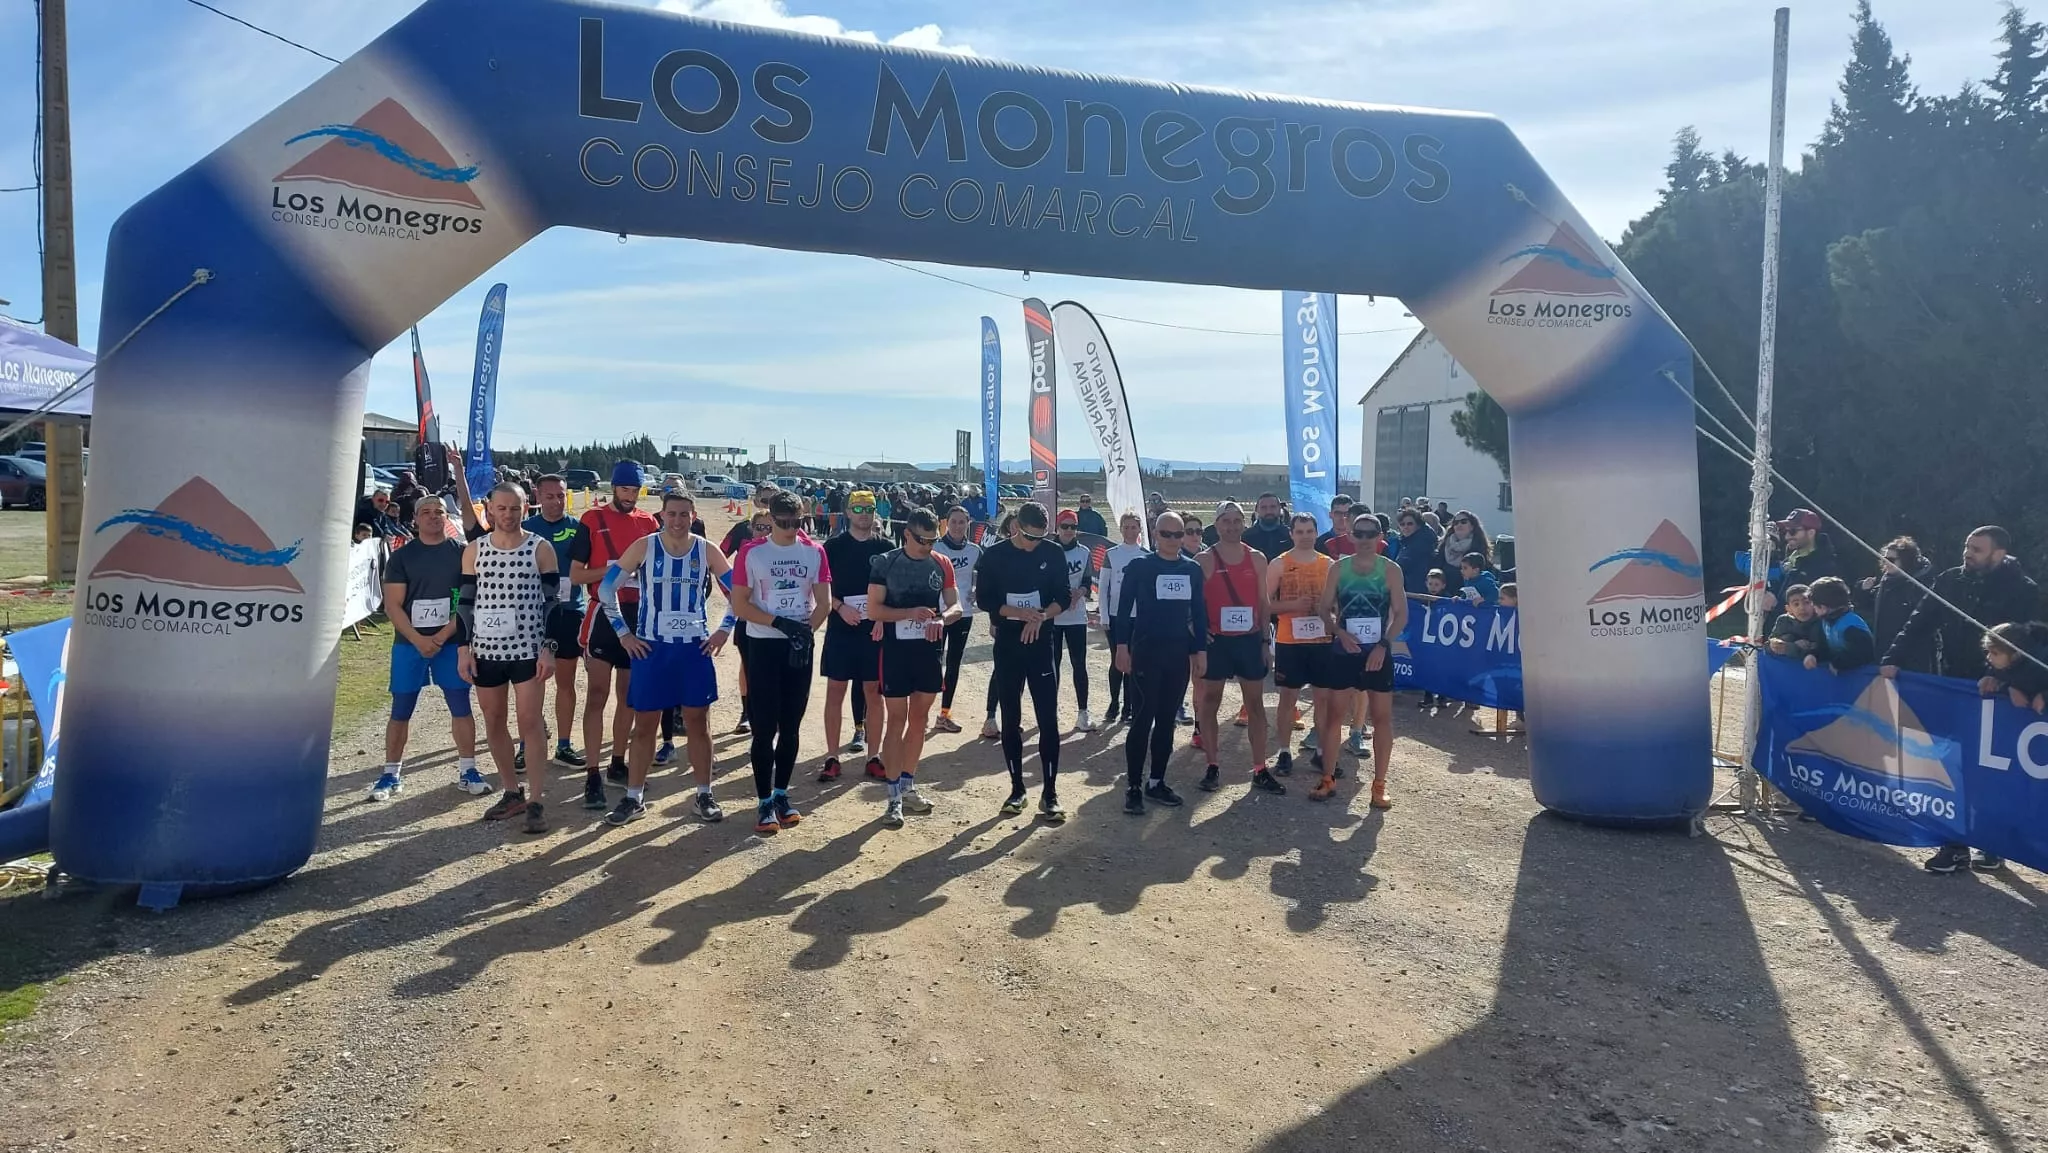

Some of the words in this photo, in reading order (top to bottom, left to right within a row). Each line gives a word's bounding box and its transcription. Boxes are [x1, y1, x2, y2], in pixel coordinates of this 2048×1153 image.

[579, 16, 813, 144] Los
[865, 58, 1451, 216] Monegros
[578, 136, 874, 213] CONSEJO
[898, 173, 1198, 243] COMARCAL
[272, 186, 324, 214] Los
[336, 195, 483, 235] Monegros
[271, 210, 339, 230] CONSEJO
[344, 220, 421, 241] COMARCAL
[1489, 299, 1527, 317] Los
[1534, 300, 1632, 322] Monegros
[1487, 315, 1535, 328] CONSEJO
[1538, 319, 1593, 328] COMARCAL
[475, 333, 494, 425] Monegros
[473, 430, 485, 461] Los
[1167, 582, 1181, 592] 48
[86, 585, 123, 613] Los
[134, 590, 304, 628] Monegros
[780, 597, 795, 608] 97
[424, 608, 438, 619] 74
[486, 617, 501, 628] 24
[1231, 614, 1243, 625] 54
[1589, 607, 1631, 626] Los
[85, 613, 137, 630] CONSEJO
[142, 618, 232, 635] COMARCAL
[671, 618, 687, 630] 29
[1303, 623, 1315, 632] 19
[1357, 624, 1371, 635] 78
[1486, 607, 1521, 654] M
[1590, 626, 1643, 637] CONSEJO
[1787, 756, 1825, 787] Los
[1833, 771, 1957, 820] Monegros
